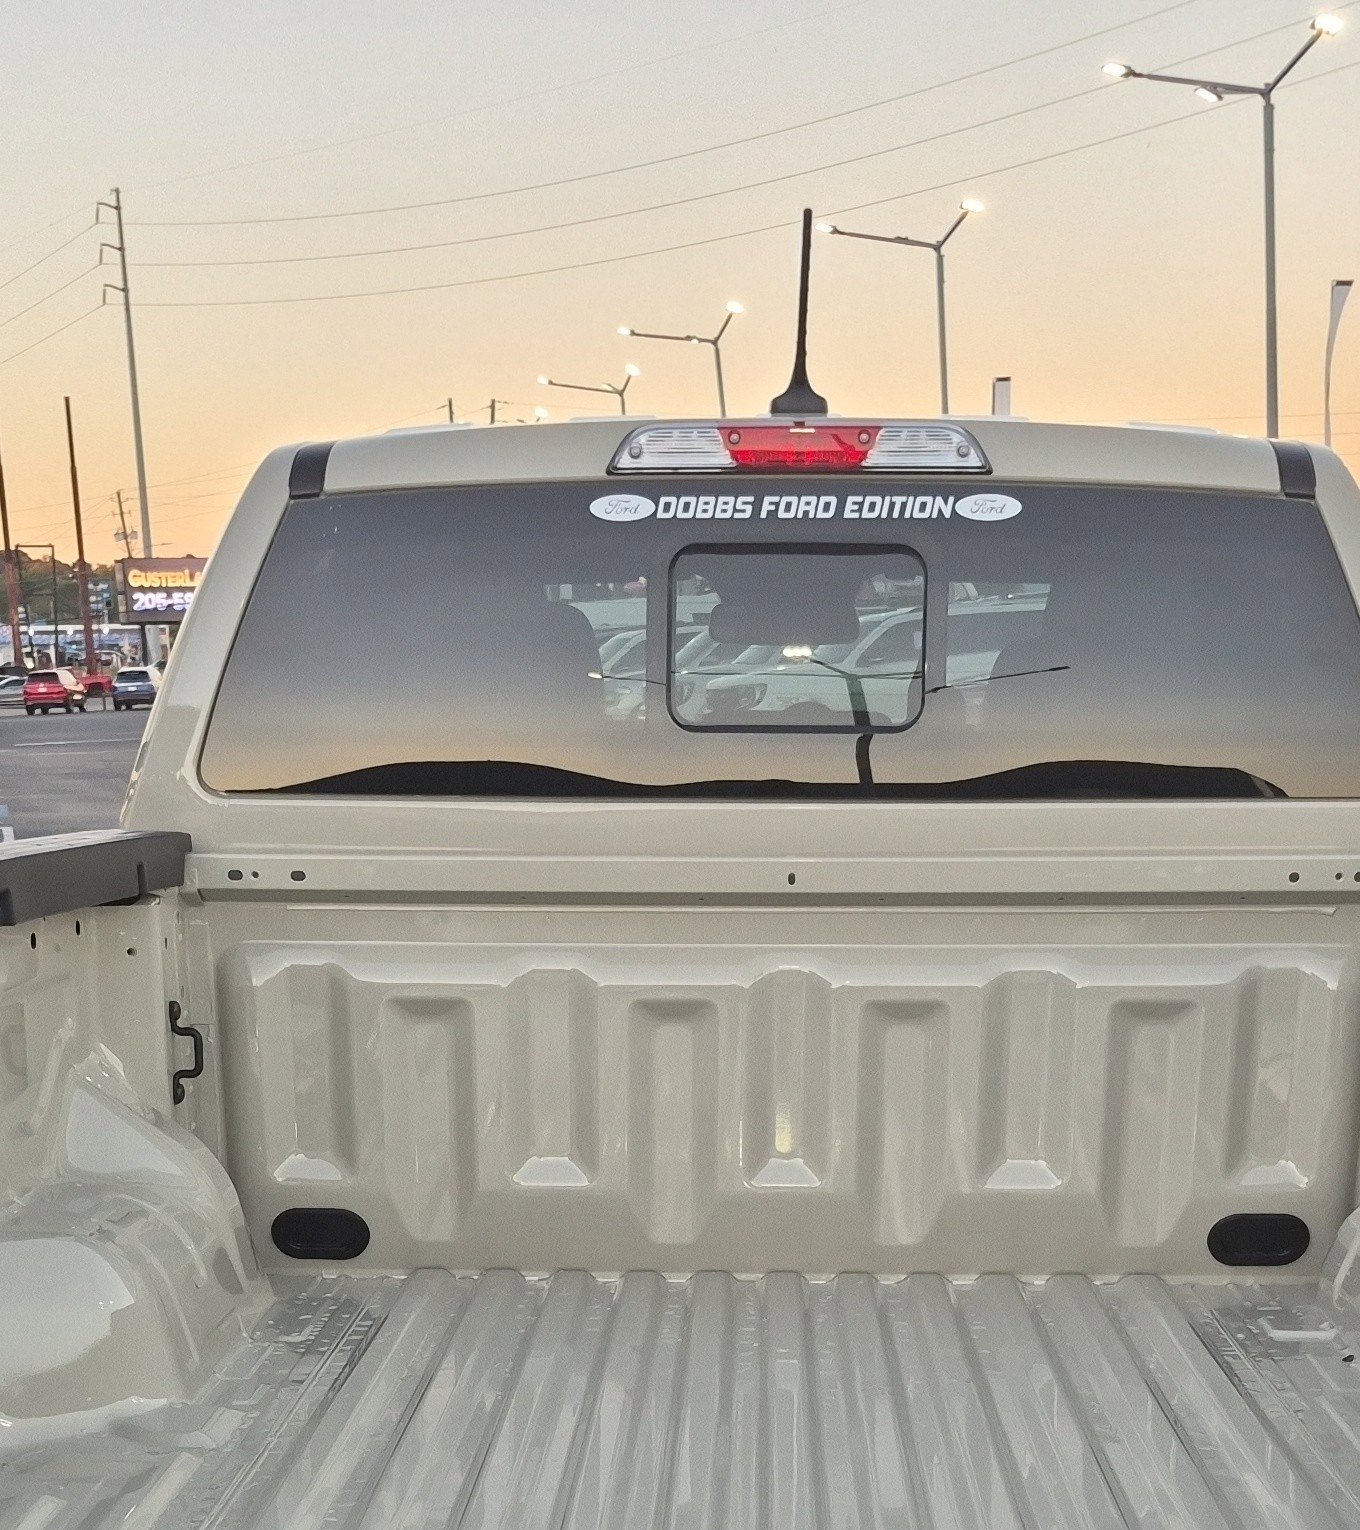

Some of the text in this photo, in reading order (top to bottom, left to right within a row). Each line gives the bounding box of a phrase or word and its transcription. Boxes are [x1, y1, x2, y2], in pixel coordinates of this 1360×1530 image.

[656, 495, 755, 519] DOBBS
[760, 495, 837, 519] FORD
[843, 495, 955, 519] EDITION
